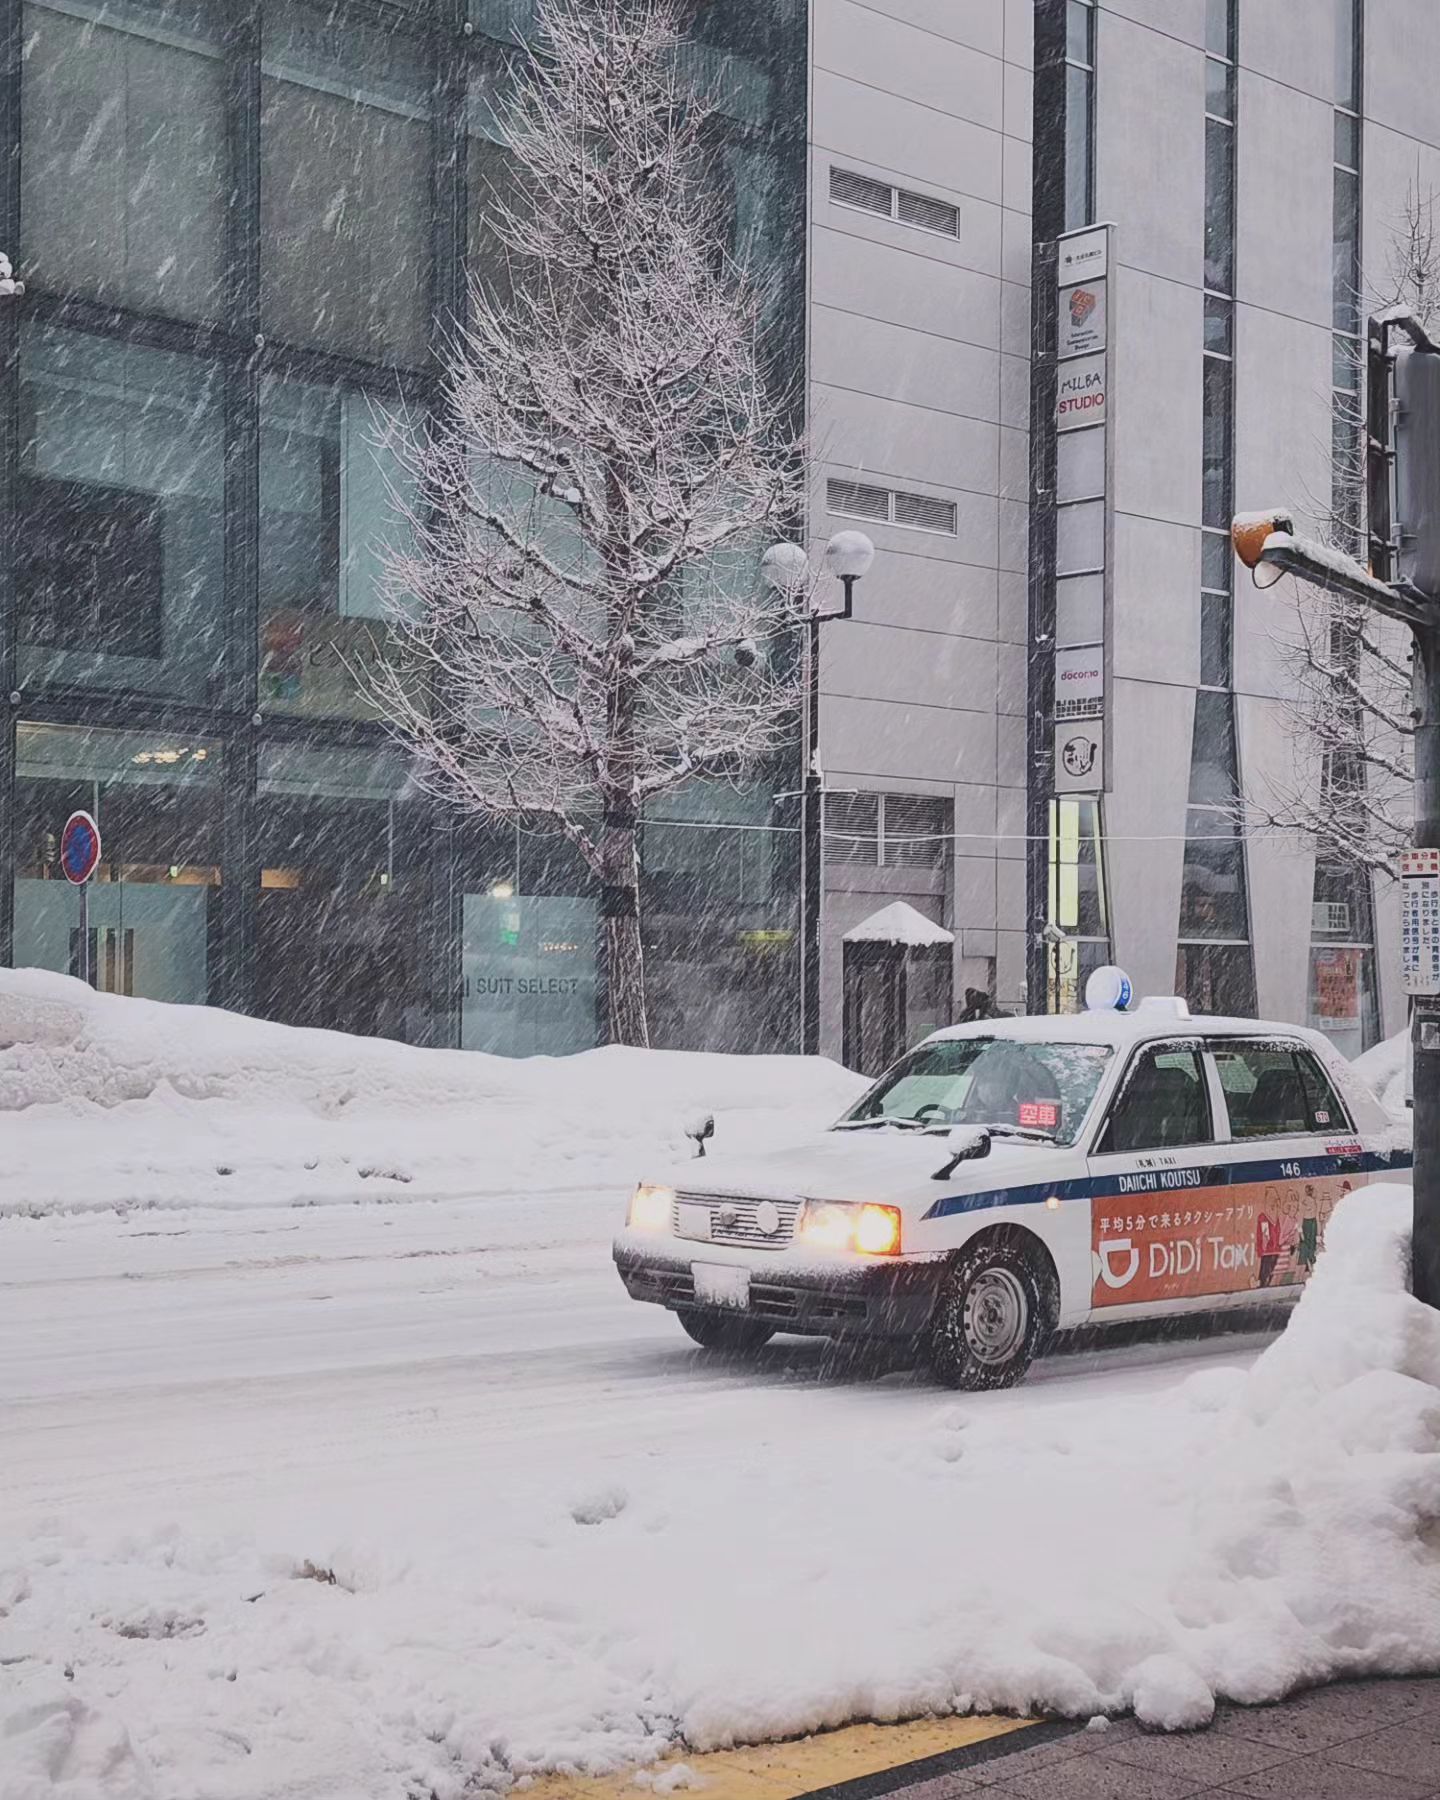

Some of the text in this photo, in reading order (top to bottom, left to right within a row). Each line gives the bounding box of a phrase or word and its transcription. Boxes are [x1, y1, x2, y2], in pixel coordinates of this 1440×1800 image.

[1061, 374, 1102, 394] MILBA
[1058, 392, 1105, 414] STUDIO
[1061, 670, 1099, 681] docomo
[476, 978, 579, 995] SUIT SELECT
[1019, 1104, 1057, 1125] 空車
[1159, 1156, 1177, 1165] TAXI
[1280, 1162, 1301, 1177] 146
[1119, 1169, 1201, 1192] DAIICHI KOUTSU
[1100, 1205, 1254, 1233] 平均5分で来るタクシーアプリ
[1149, 1233, 1255, 1278] DiDi Taxi
